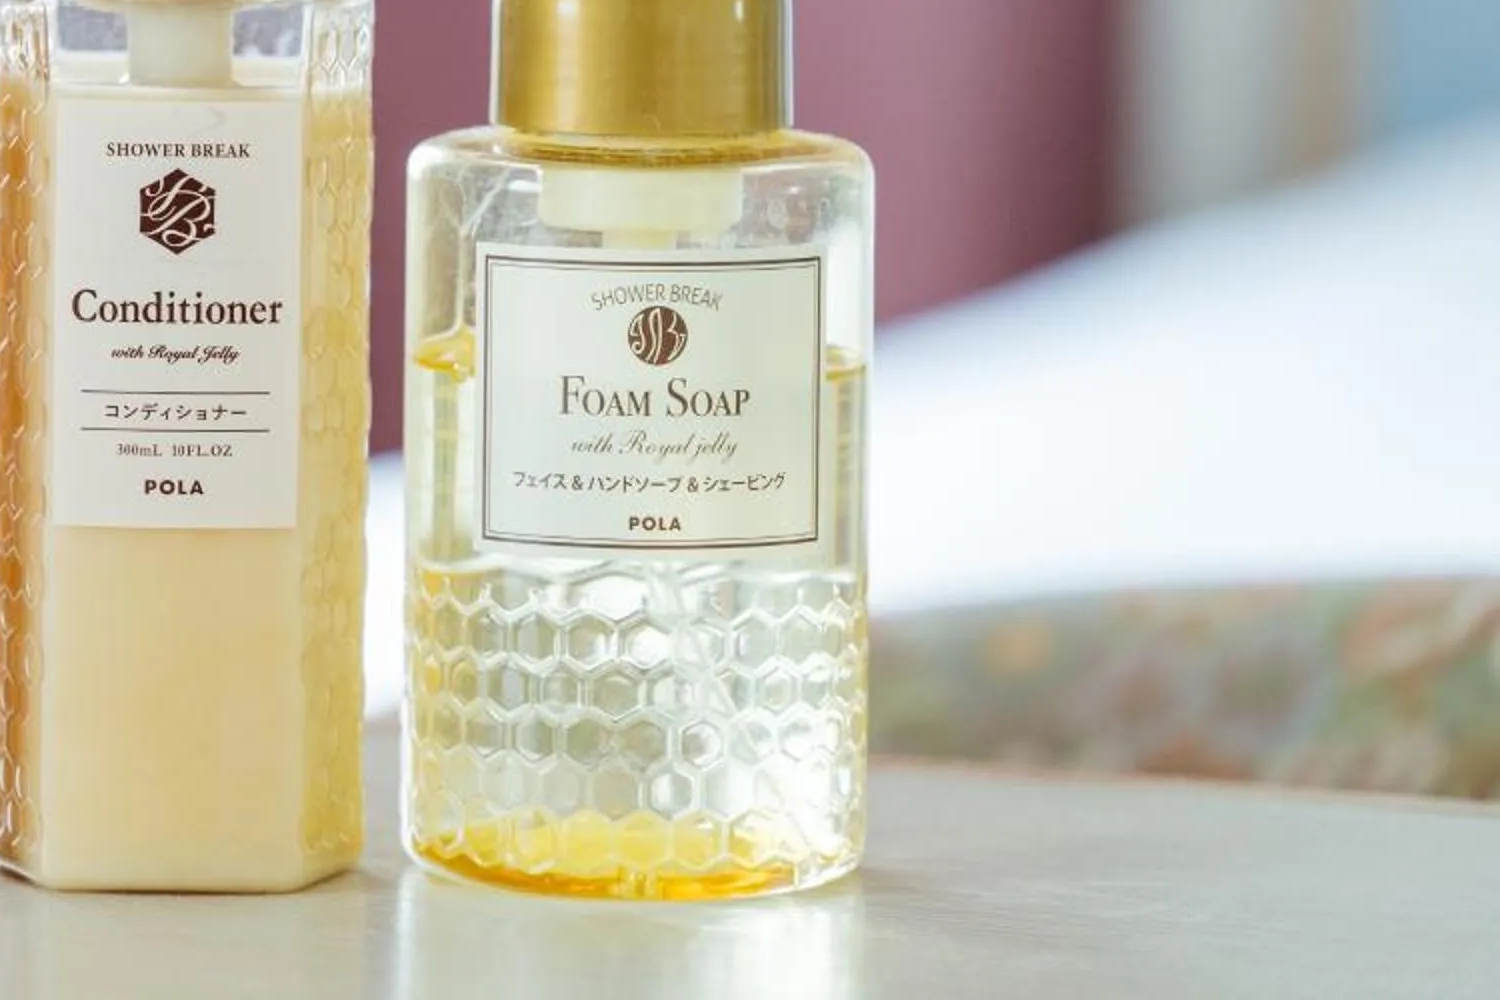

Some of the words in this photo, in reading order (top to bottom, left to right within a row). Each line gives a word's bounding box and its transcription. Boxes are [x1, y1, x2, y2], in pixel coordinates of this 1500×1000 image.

[106, 142, 186, 158] SHOWER
[190, 143, 250, 158] BREAK
[591, 283, 665, 311] SHOWER
[669, 284, 722, 311] BREAK
[71, 288, 282, 325] Conditioner
[110, 345, 144, 359] with
[148, 345, 198, 361] Royal
[197, 345, 239, 363] Jelly
[559, 375, 651, 418] FOAM
[666, 378, 751, 418] SOAP
[104, 402, 247, 421] コンディショナー
[116, 444, 163, 457] 300mL
[571, 432, 613, 455] with
[618, 431, 694, 464] Royal
[692, 431, 738, 464] jelly
[144, 480, 204, 495] POLA
[629, 516, 681, 531] POLA
